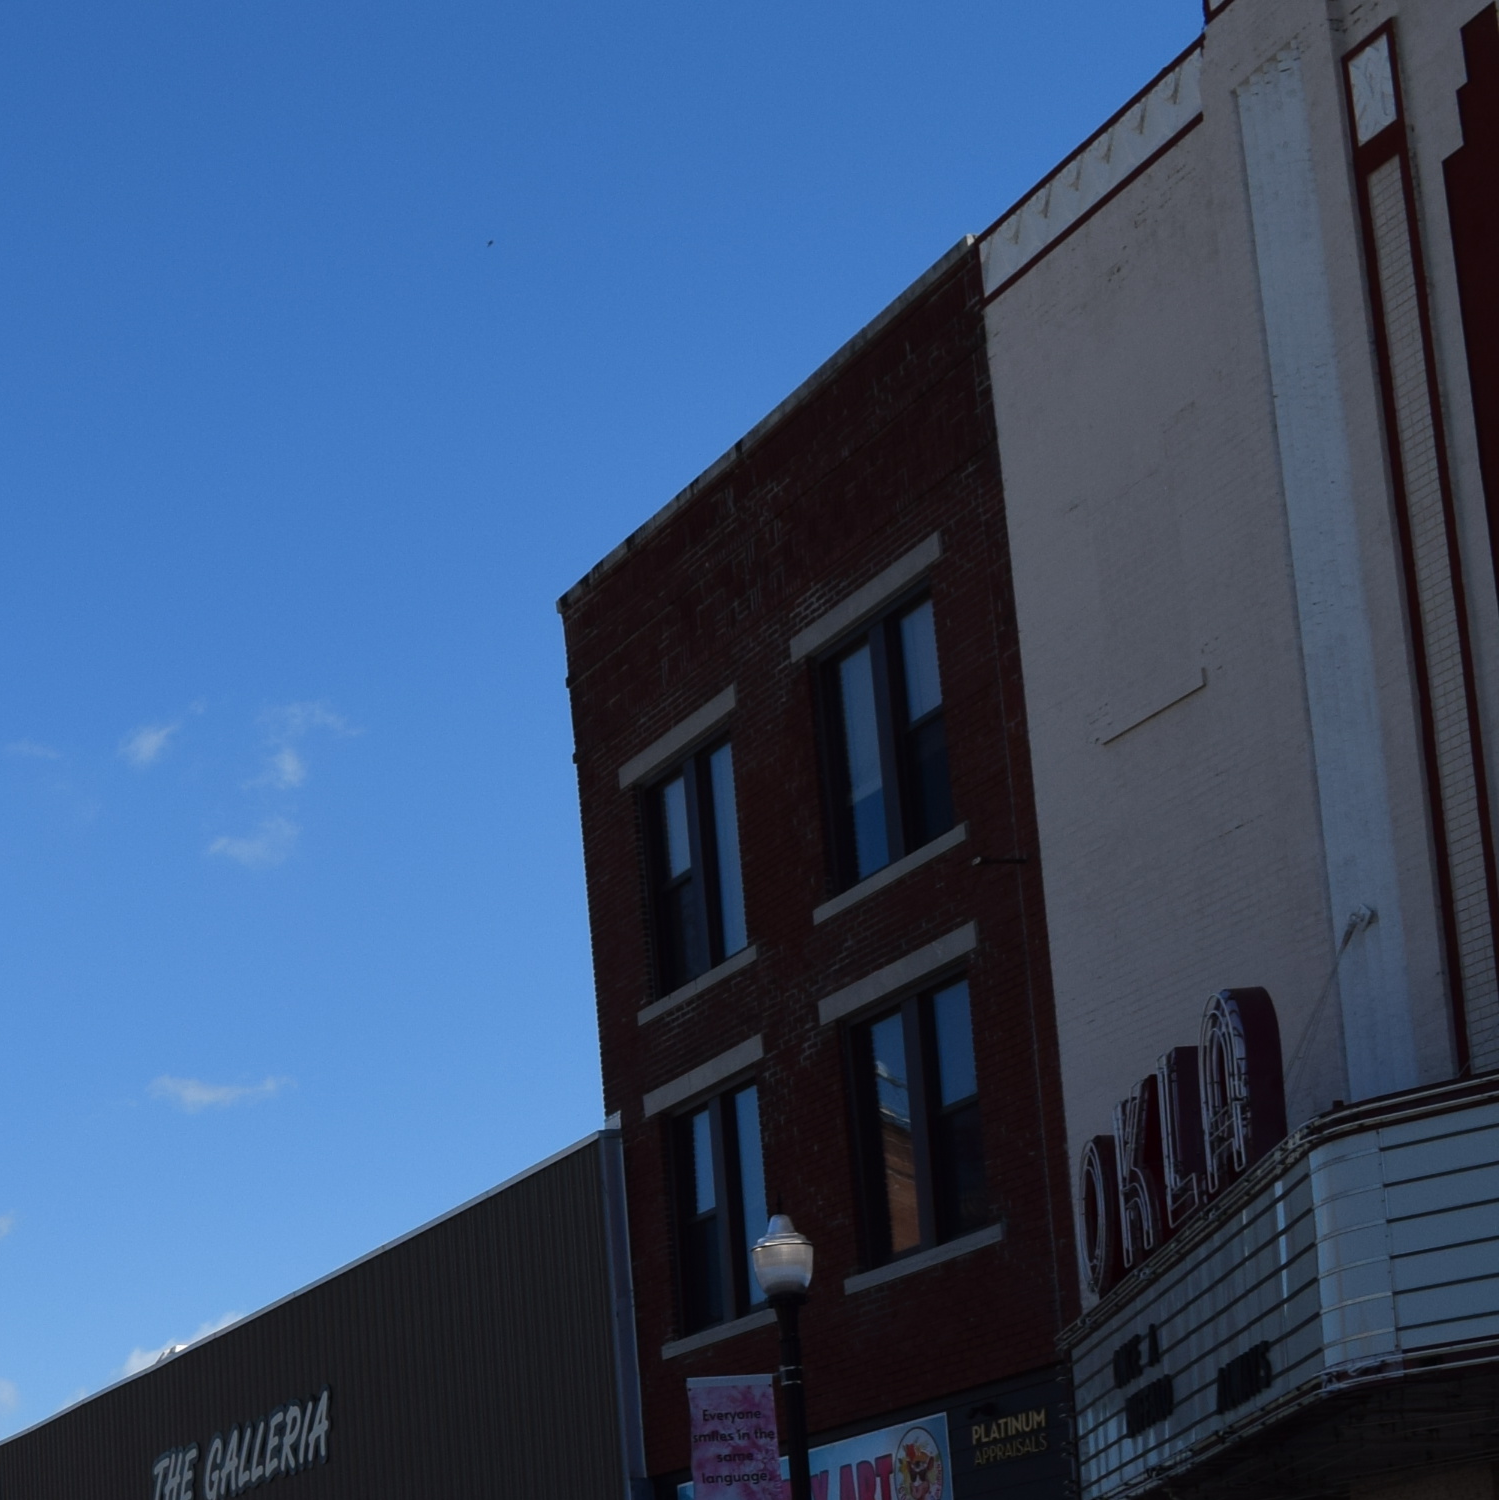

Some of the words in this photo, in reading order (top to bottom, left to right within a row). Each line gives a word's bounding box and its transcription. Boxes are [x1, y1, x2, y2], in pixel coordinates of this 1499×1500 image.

[703, 1409, 761, 1423] Everyone
[972, 1408, 1045, 1445] PLATINUM
[693, 1430, 734, 1443] smiles
[737, 1429, 750, 1441] in
[754, 1428, 775, 1440] the
[716, 1452, 753, 1462] same
[974, 1433, 1048, 1466] APPRAISALS
